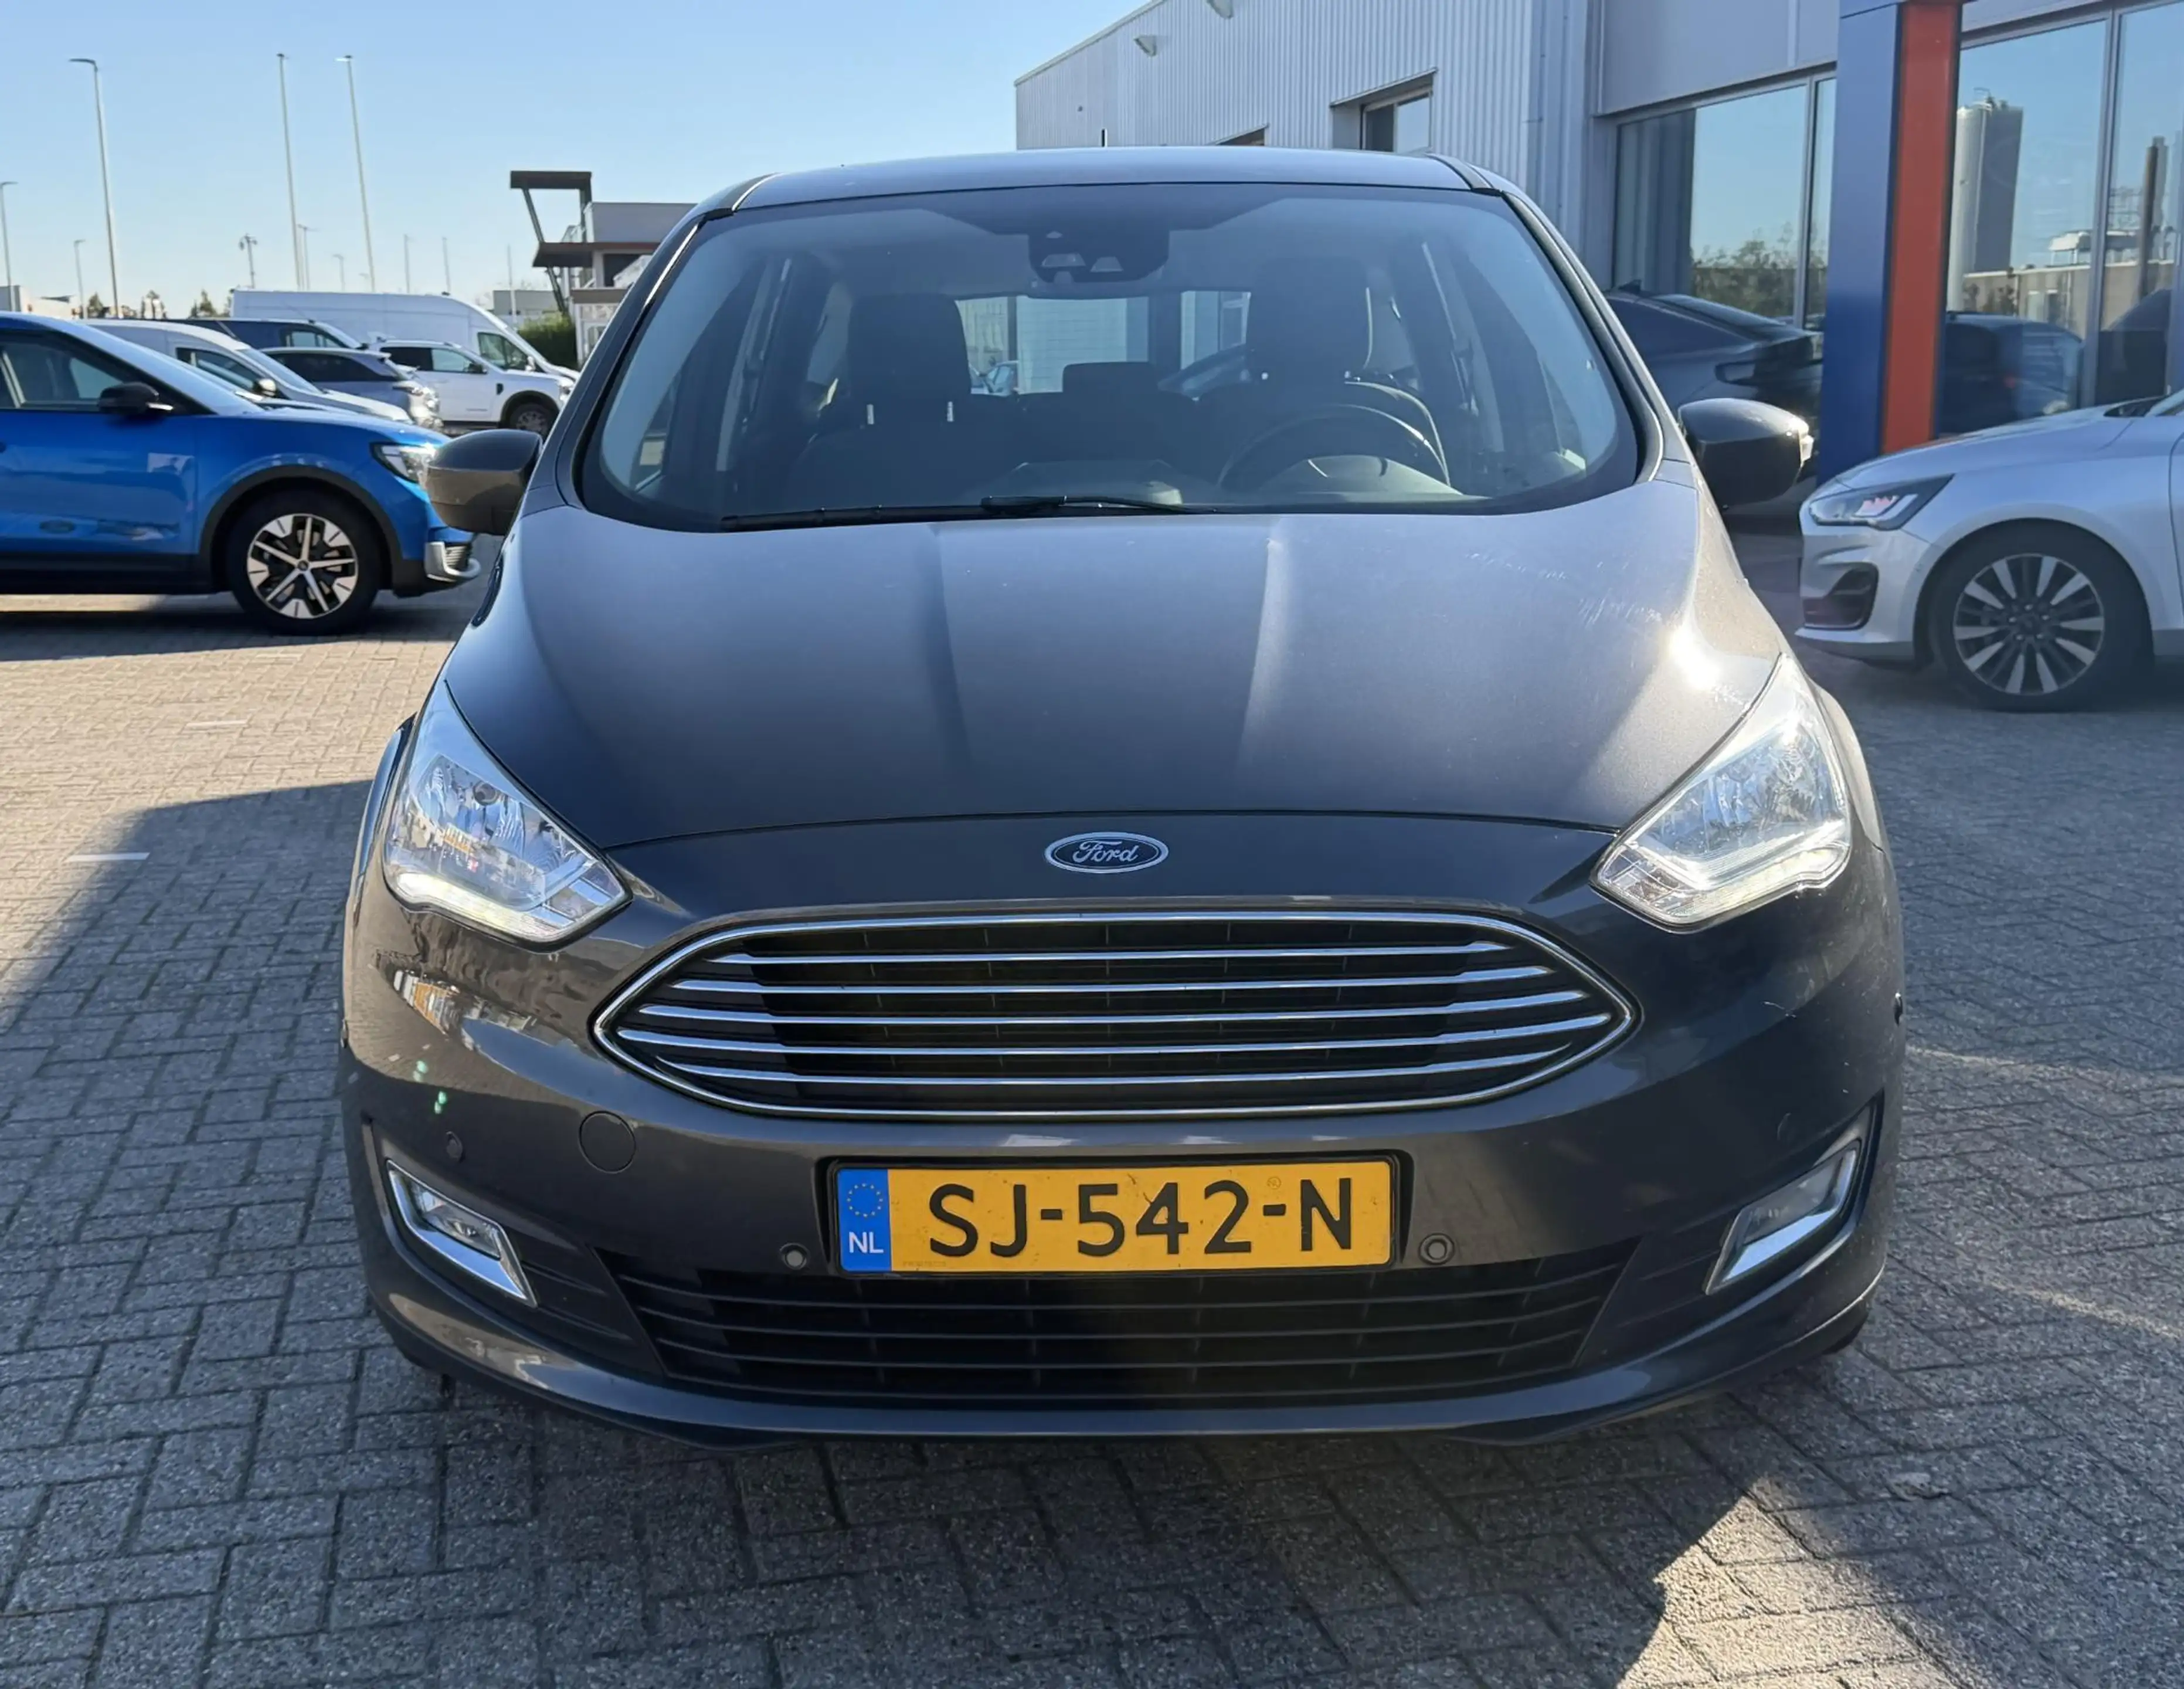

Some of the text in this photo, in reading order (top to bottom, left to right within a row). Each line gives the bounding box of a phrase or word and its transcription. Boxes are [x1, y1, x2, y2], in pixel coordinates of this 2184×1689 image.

[1072, 840, 1140, 863] Ford
[929, 1178, 1352, 1258] SJ-542-N
[848, 1232, 884, 1253] NL
